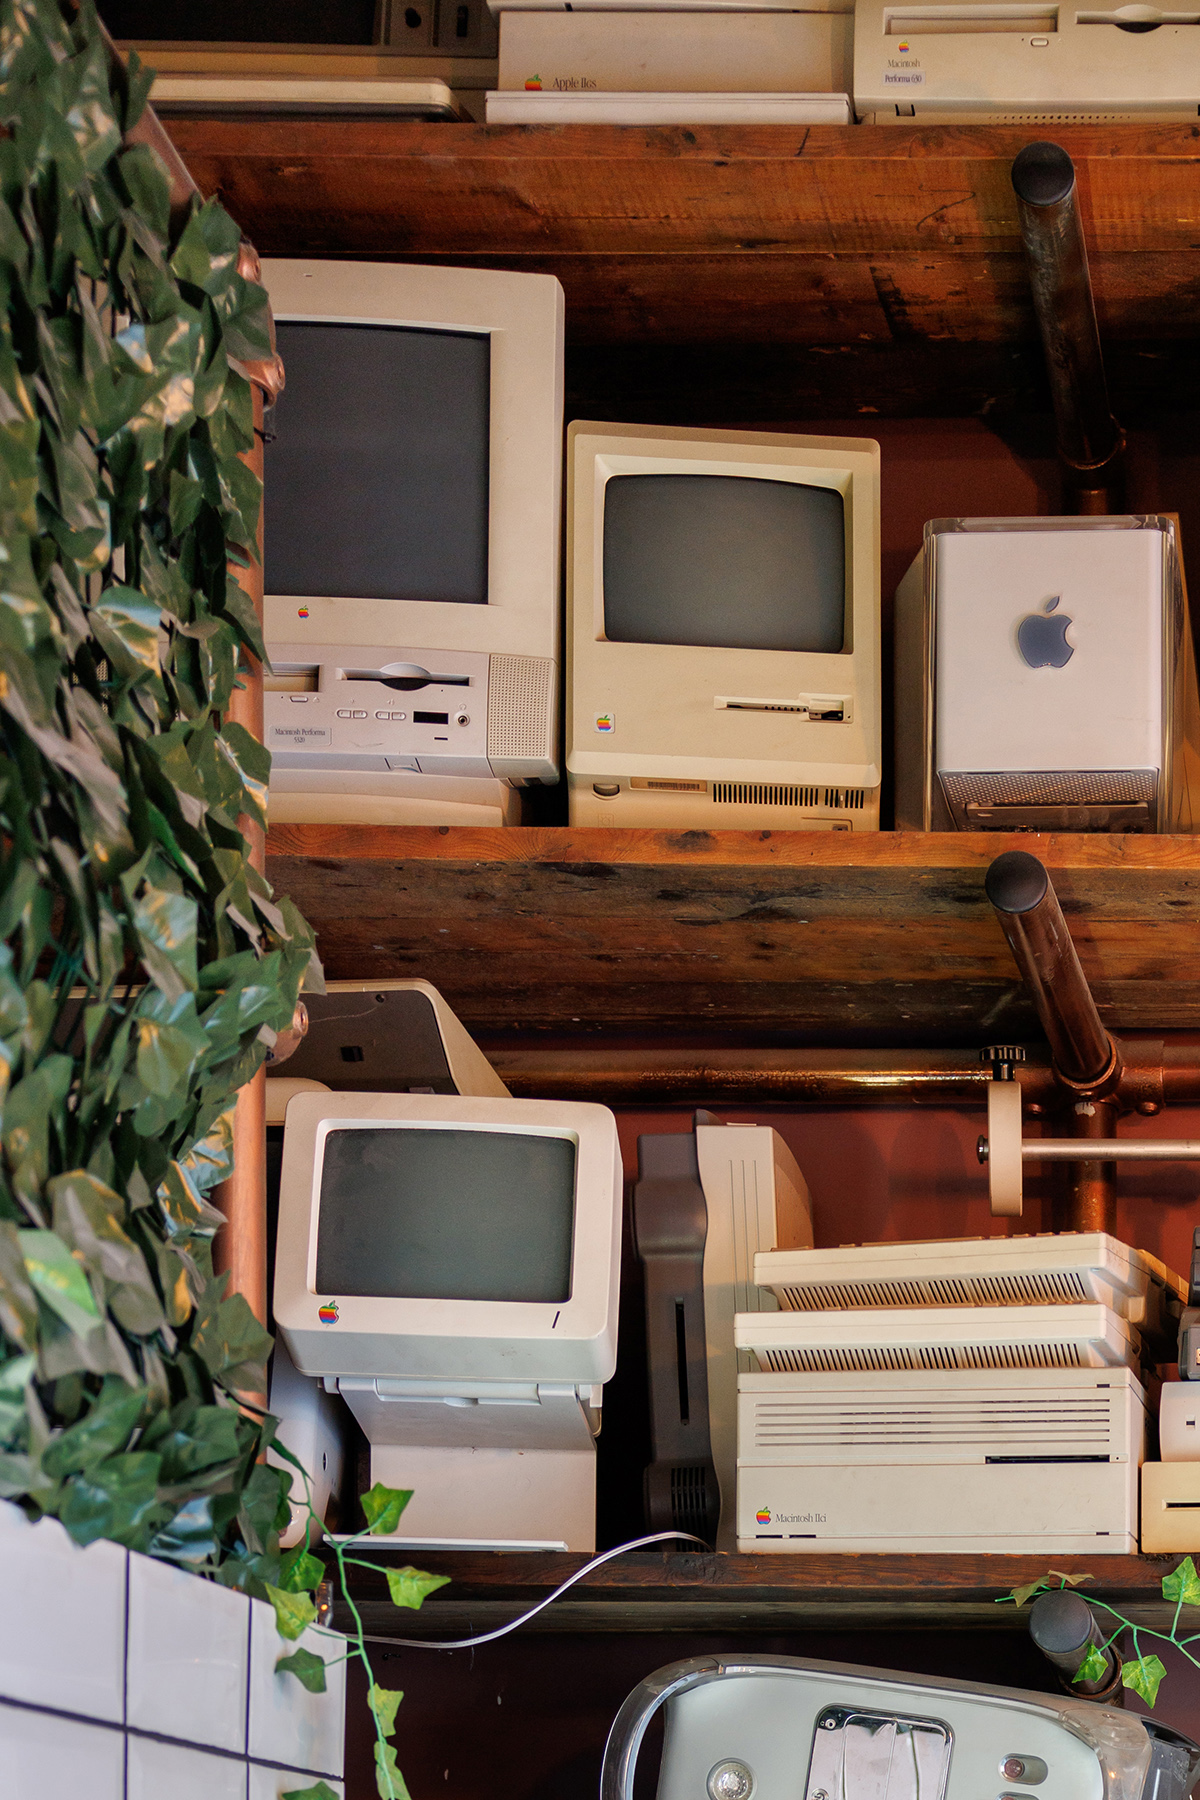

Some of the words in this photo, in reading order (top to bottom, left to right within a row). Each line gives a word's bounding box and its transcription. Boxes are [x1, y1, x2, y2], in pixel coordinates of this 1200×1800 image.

[887, 58, 921, 68] Macintosh
[885, 74, 910, 83] Performa
[553, 77, 579, 91] Apple
[275, 728, 300, 736] Macintosh
[301, 728, 326, 736] Performa
[775, 1512, 814, 1523] Macintosh
